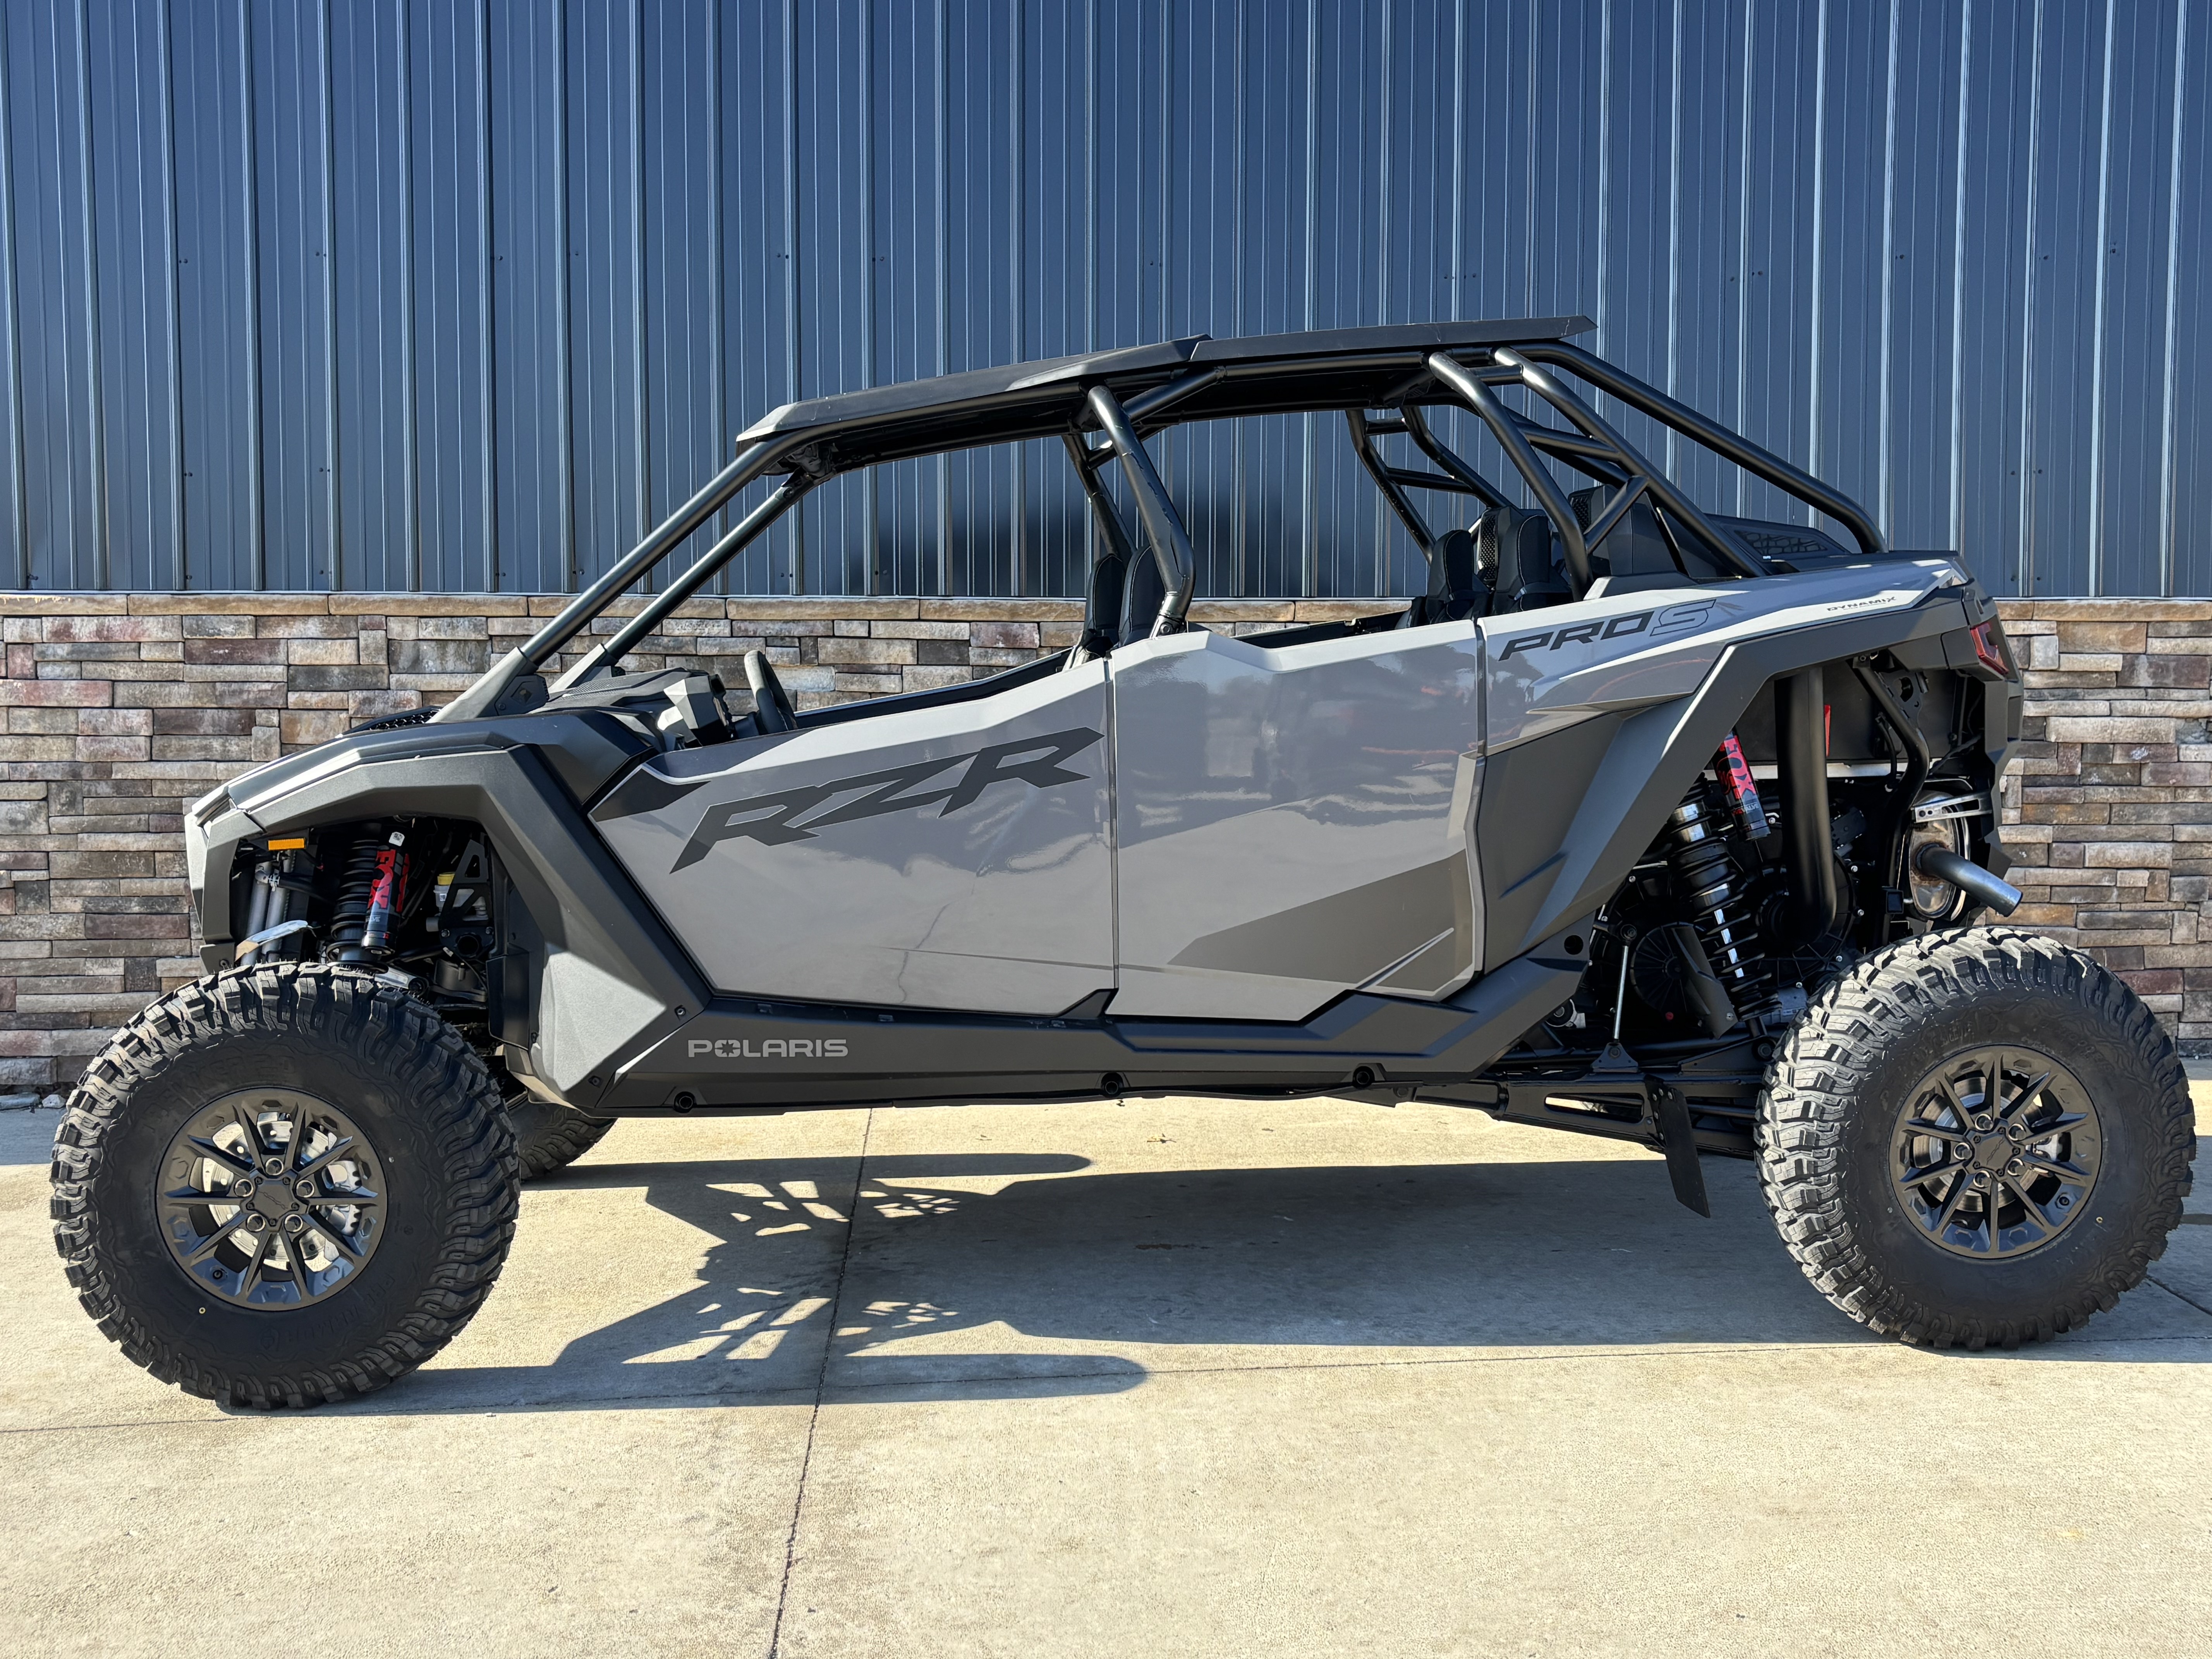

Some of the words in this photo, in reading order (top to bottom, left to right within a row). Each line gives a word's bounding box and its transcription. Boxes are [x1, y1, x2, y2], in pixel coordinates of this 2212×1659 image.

[1827, 597, 1896, 611] DYNAMIX
[670, 726, 1104, 874] RZR
[367, 849, 396, 909] FOX
[688, 1039, 848, 1058] POLARIS
